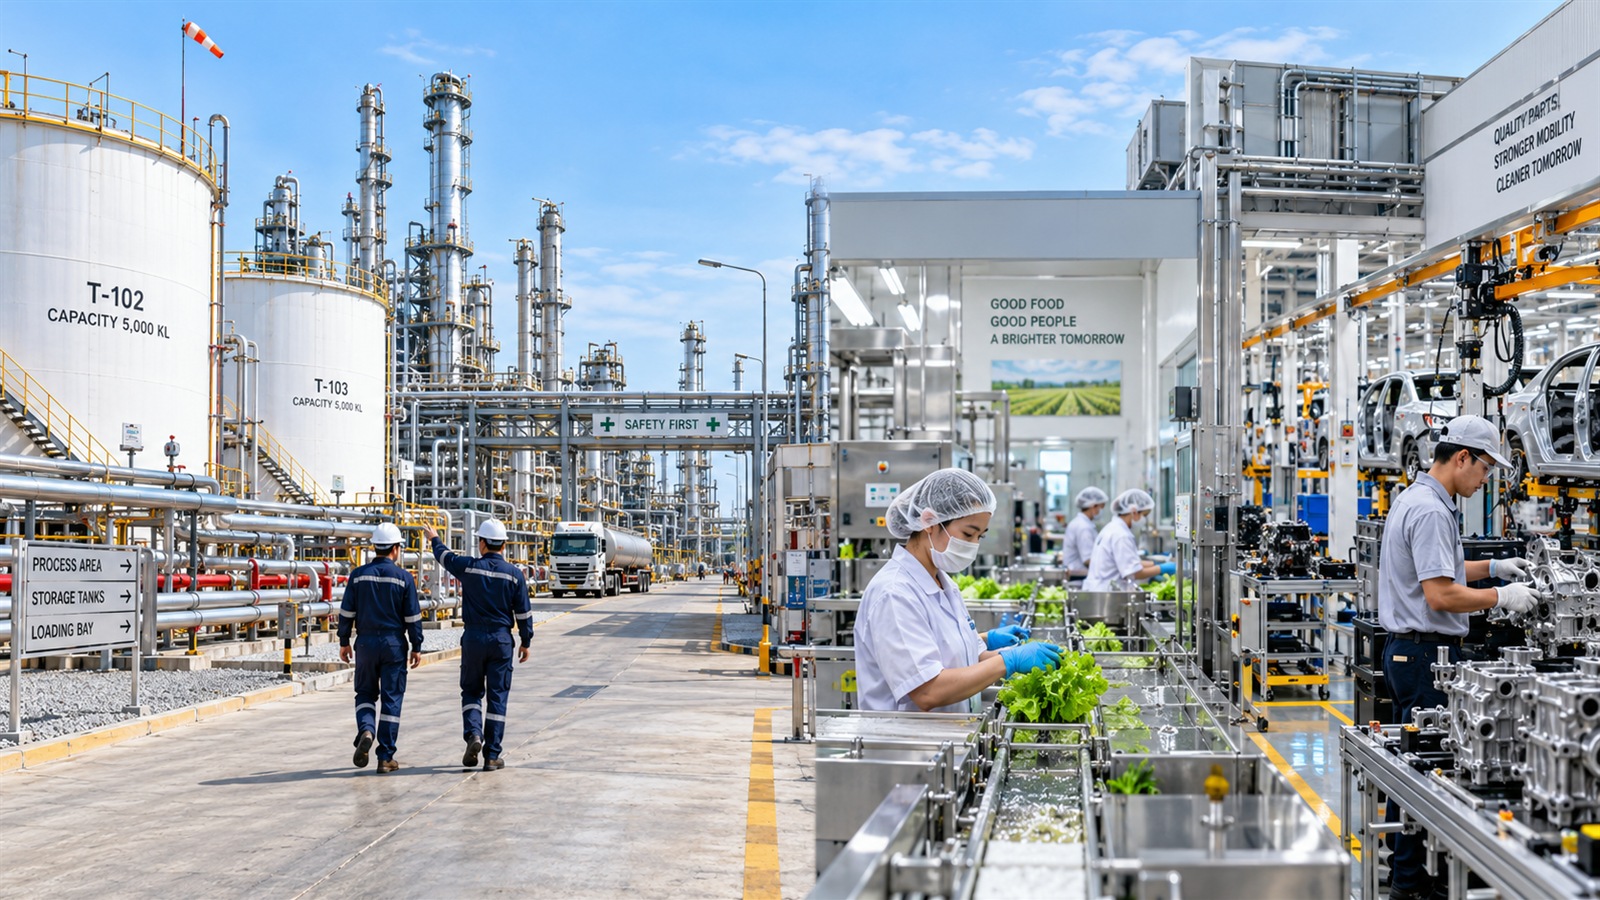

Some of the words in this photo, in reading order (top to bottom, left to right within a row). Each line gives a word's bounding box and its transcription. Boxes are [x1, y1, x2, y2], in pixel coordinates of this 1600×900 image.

[1494, 111, 1527, 146] QUALITY
[1494, 134, 1535, 170] STRONGER
[1536, 110, 1576, 147] MOBILITY
[1496, 164, 1531, 193] CLEANER
[1532, 137, 1582, 177] TOMORROW
[87, 281, 144, 311] T-102
[990, 298, 1027, 310] GOOD
[1030, 298, 1065, 310] FOOD
[47, 307, 118, 329] CAPACITY
[122, 317, 154, 335] 5,000
[157, 324, 170, 339] KL
[990, 316, 1027, 327] GOOD
[1030, 316, 1077, 327] PEOPLE
[990, 333, 999, 345] A
[1002, 333, 1057, 345] BRIGHTER
[1059, 333, 1125, 345] TOMORROW
[314, 378, 348, 396] T-103
[292, 396, 333, 408] CAPACITY
[334, 400, 354, 411] 5,000
[354, 403, 363, 413] KL
[624, 419, 666, 430] SAFETY
[669, 419, 699, 430] FIRST
[32, 557, 77, 572] PROCESS
[79, 558, 102, 572] AREA
[31, 590, 76, 605] STORAGE
[77, 590, 105, 604] TANKS
[31, 623, 74, 640] LOADING
[76, 621, 94, 636] BAY
